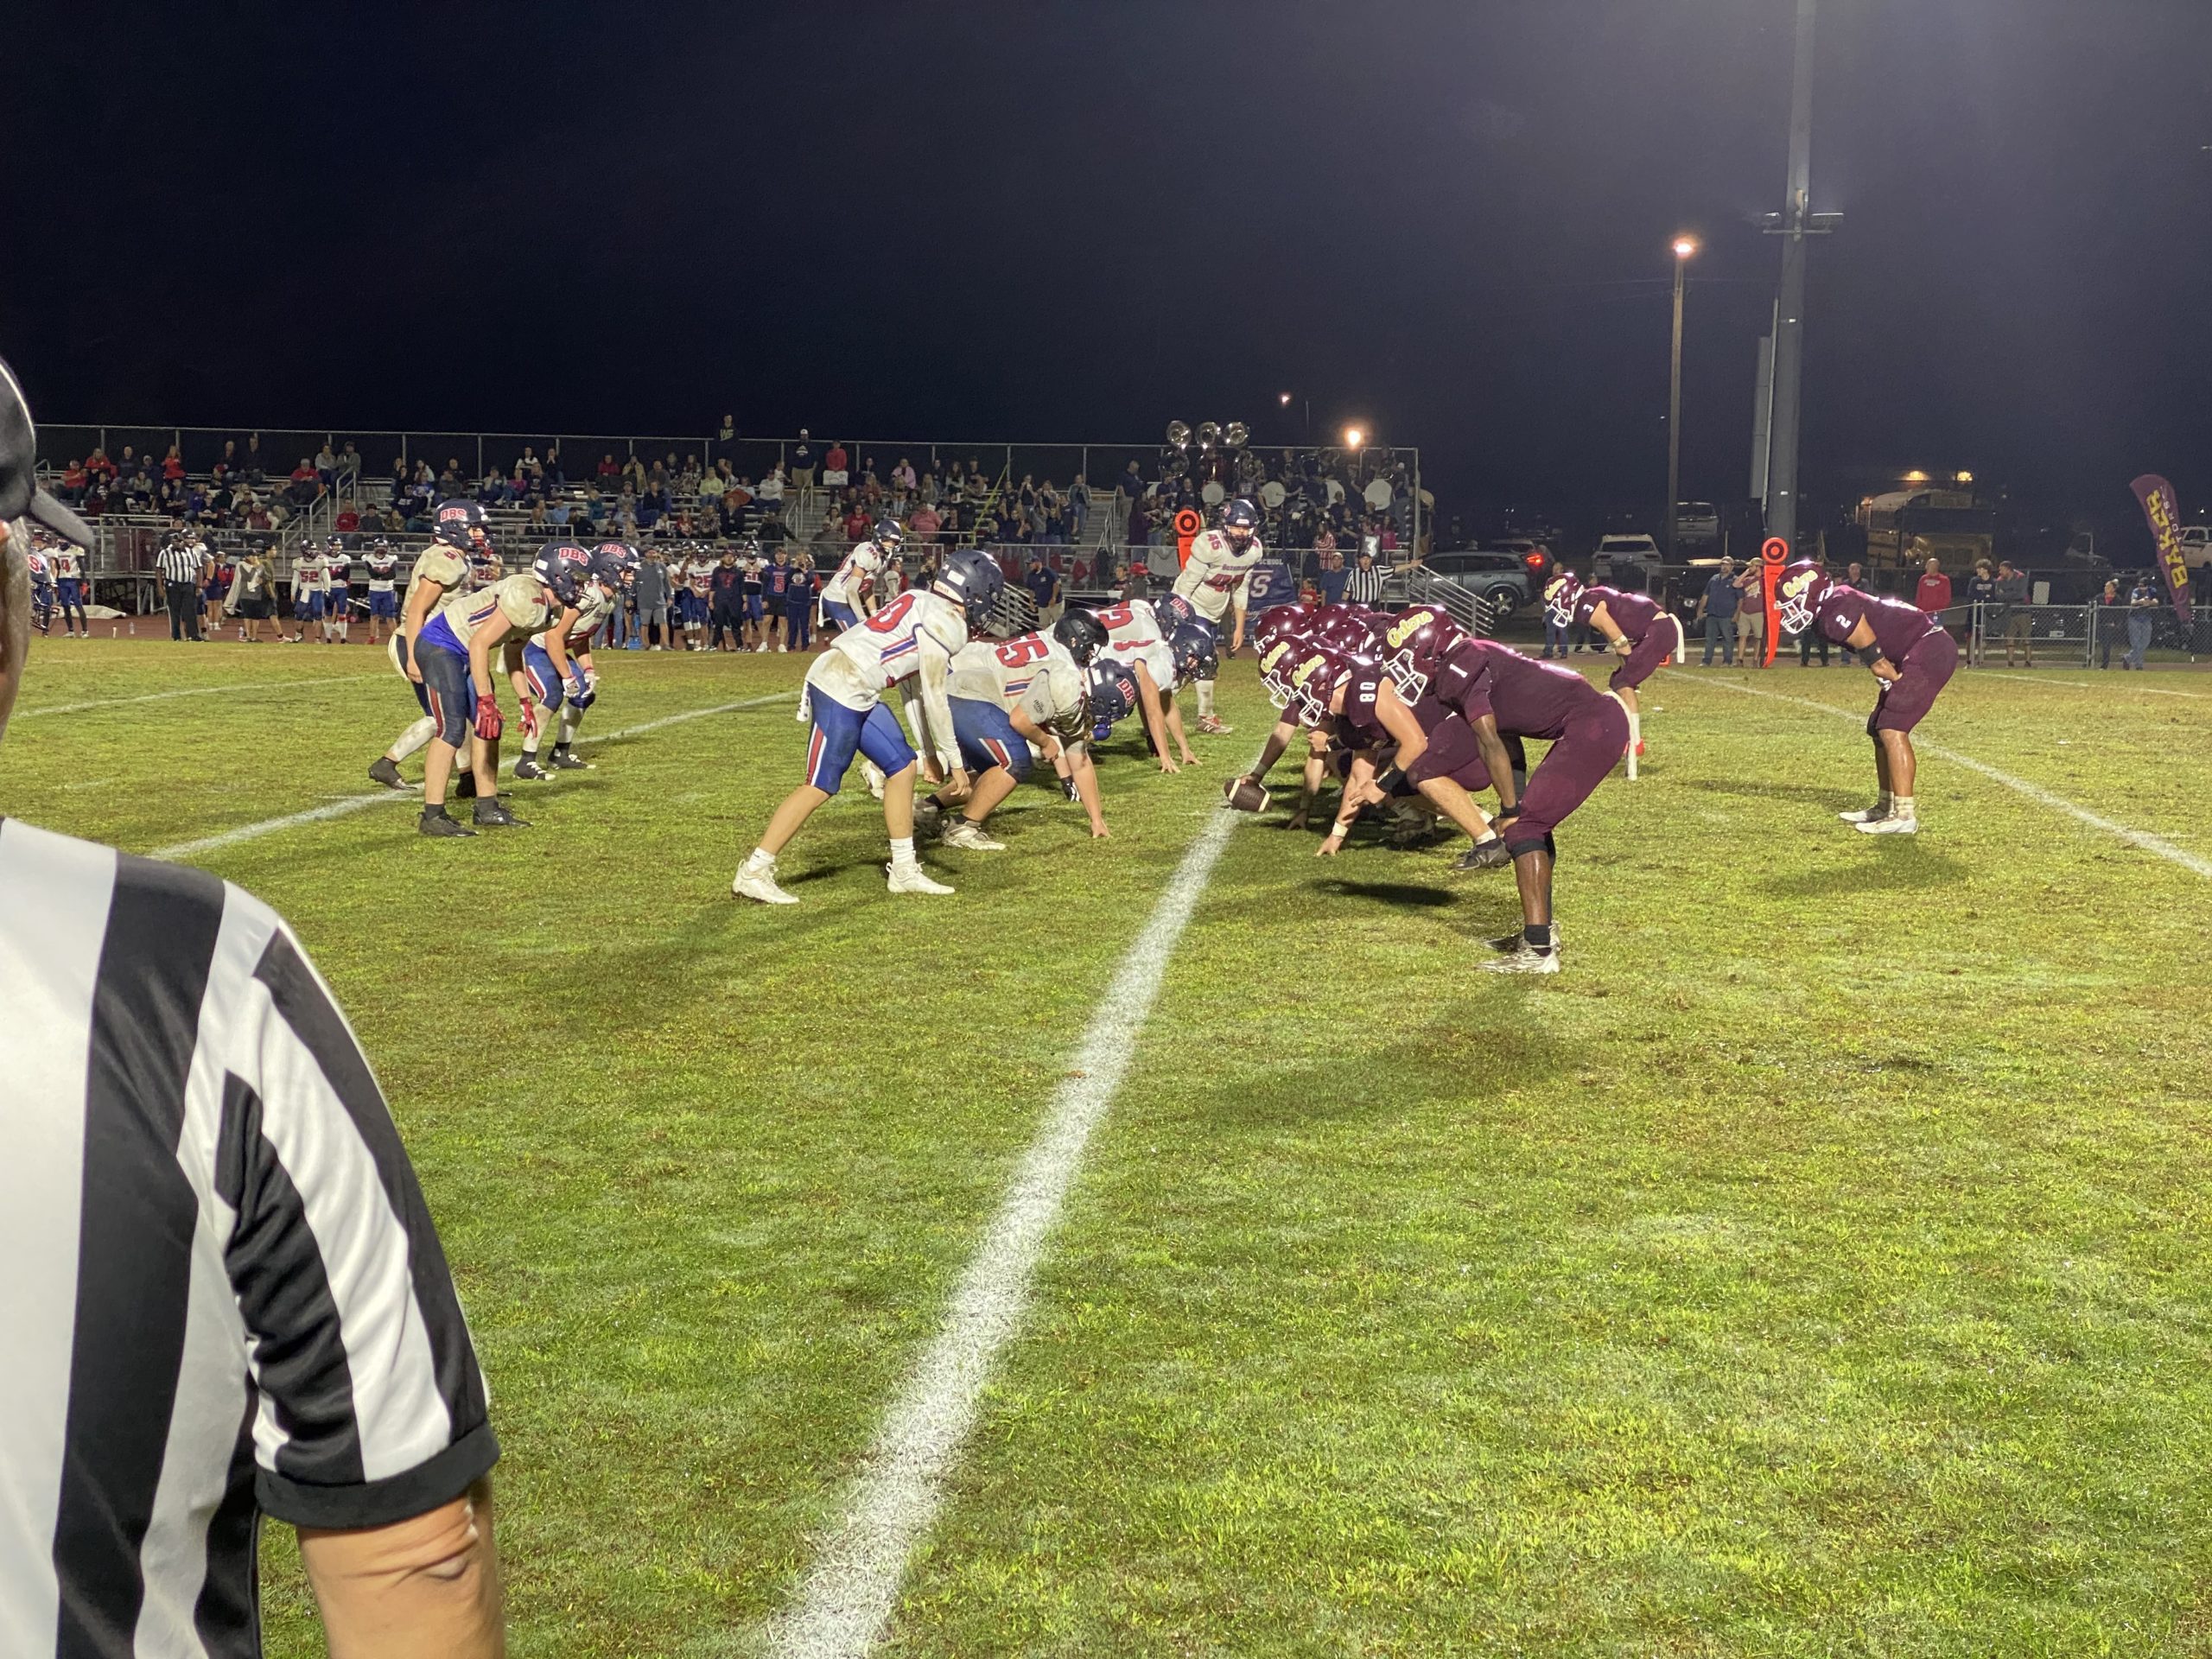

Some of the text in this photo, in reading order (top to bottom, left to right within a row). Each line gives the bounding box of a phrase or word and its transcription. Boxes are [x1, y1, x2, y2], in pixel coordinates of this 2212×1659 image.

[440, 508, 467, 522] DBS
[2146, 489, 2188, 588] BAKER
[558, 547, 588, 566] DBS
[601, 544, 626, 558] DBS
[299, 570, 319, 583] 52
[773, 575, 785, 593] 5
[1169, 598, 1189, 619] DBS
[1387, 611, 1434, 648] Gators
[1835, 614, 1853, 629] 2
[1261, 641, 1291, 674] Gators
[1292, 654, 1326, 688] Gators
[1449, 663, 1469, 678] 1
[1116, 678, 1135, 708] DBS
[1359, 682, 1376, 702] 80
